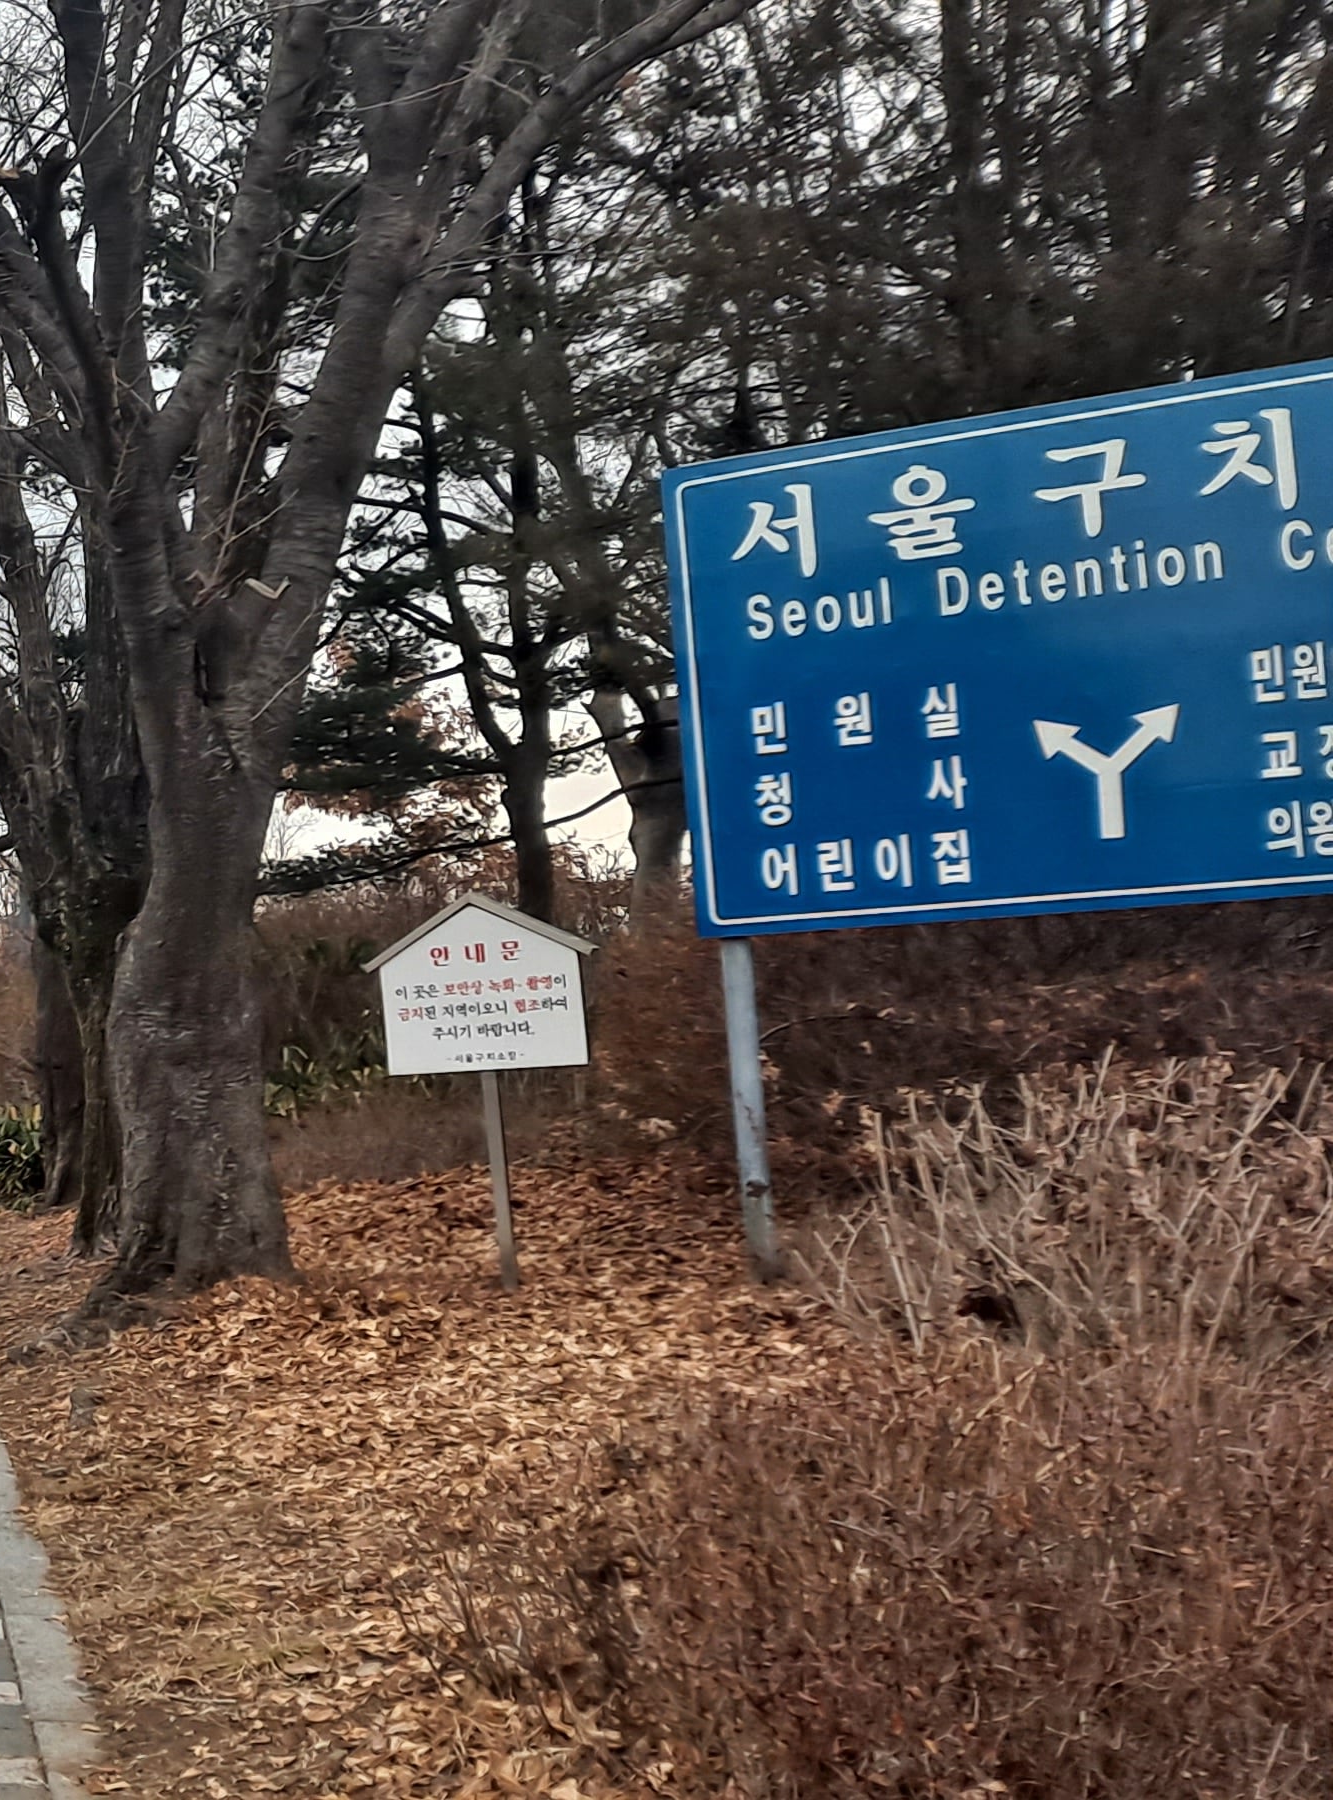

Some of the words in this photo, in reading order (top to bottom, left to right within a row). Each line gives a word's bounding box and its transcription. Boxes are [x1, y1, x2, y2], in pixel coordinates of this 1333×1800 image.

[747, 577, 893, 642] Seoul
[939, 539, 1225, 618] Detention
[751, 683, 963, 756] 민원실
[760, 828, 973, 896] 어린이집
[429, 940, 521, 967] 안내문
[432, 1024, 471, 1040] 주시기
[442, 1000, 508, 1018] 지역이오니
